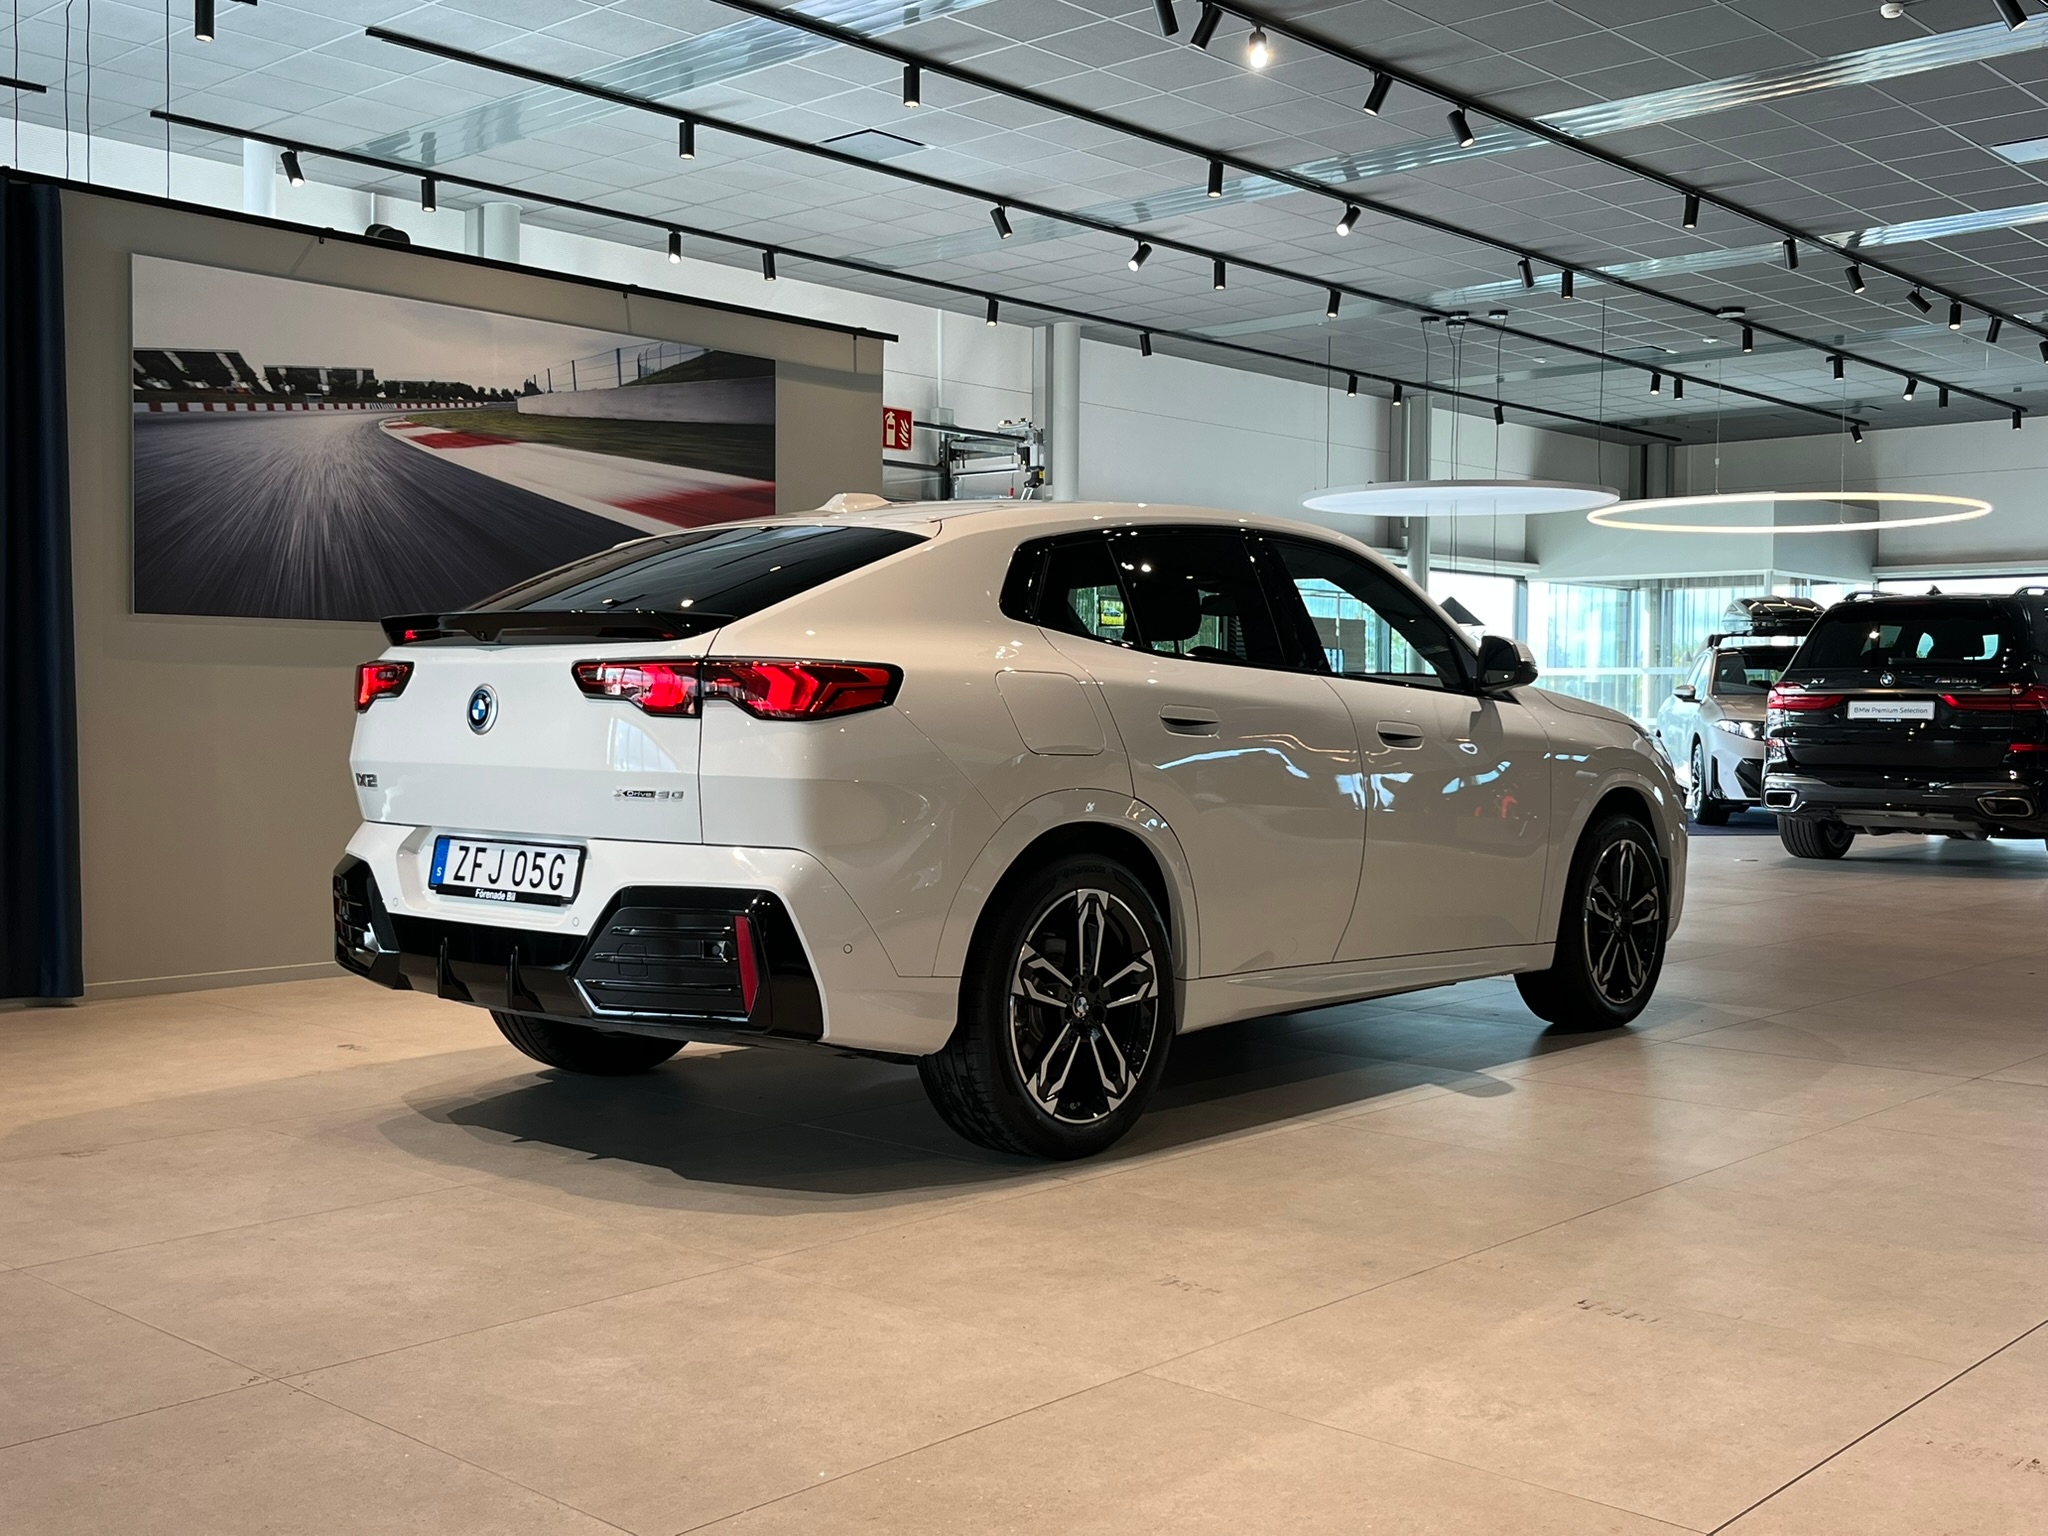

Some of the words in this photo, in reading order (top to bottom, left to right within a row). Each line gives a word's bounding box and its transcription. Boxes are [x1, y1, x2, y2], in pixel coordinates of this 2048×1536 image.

[1854, 706, 1870, 714] BMW
[1871, 706, 1898, 714] Premium
[1899, 707, 1928, 715] Selection
[436, 866, 443, 877] S
[453, 845, 505, 884] ZFJ
[511, 850, 566, 891] 05G
